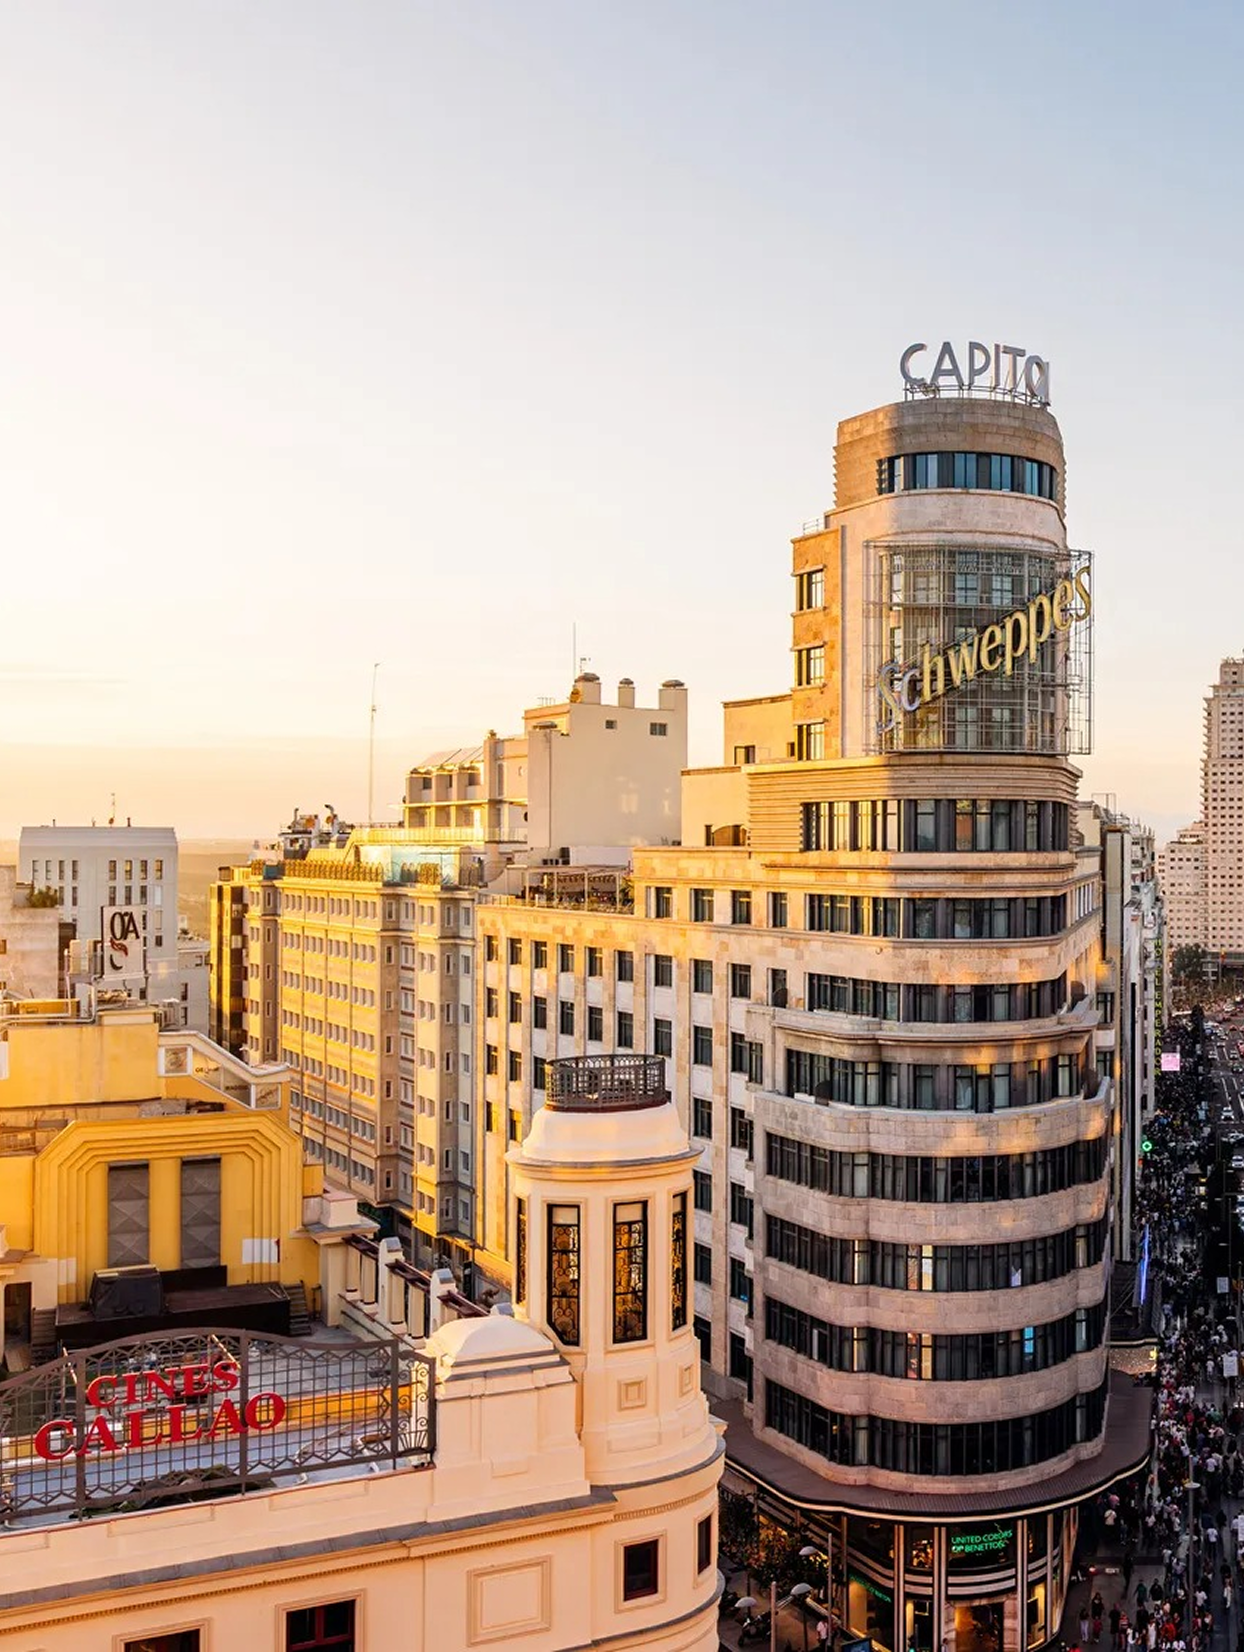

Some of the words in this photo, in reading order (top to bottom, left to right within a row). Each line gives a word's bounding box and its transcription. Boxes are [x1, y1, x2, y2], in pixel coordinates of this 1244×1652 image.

[875, 565, 1092, 735] Schweppes
[86, 1361, 241, 1408] CINES
[34, 1392, 286, 1460] CALLAO
[951, 1535, 982, 1544] UNITED
